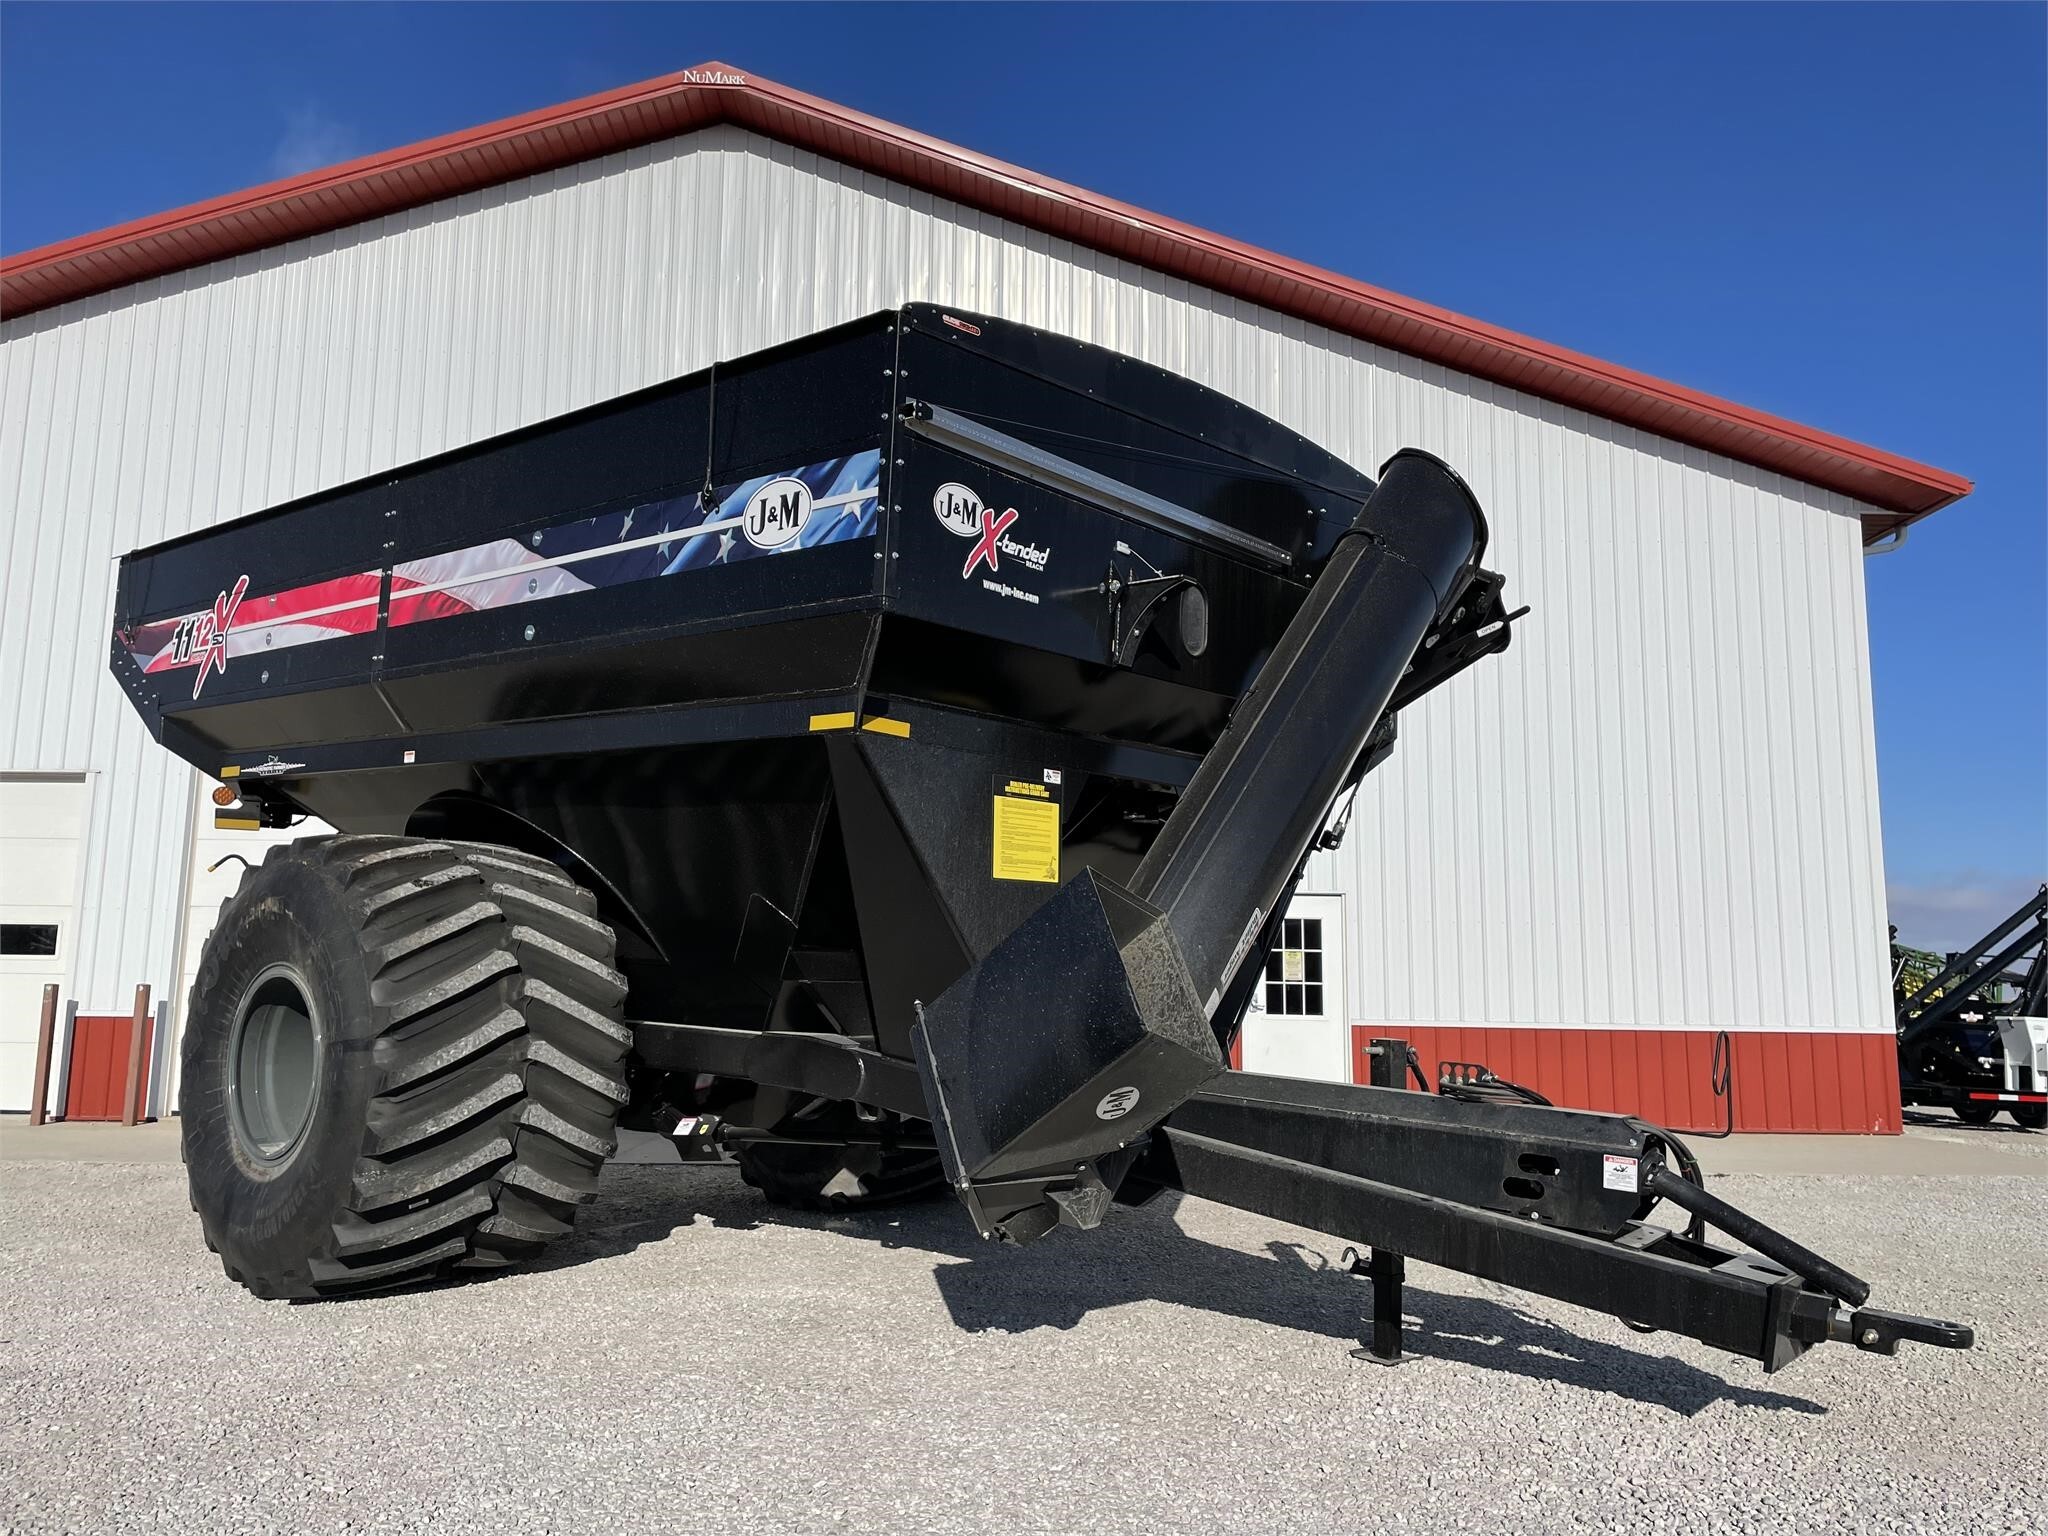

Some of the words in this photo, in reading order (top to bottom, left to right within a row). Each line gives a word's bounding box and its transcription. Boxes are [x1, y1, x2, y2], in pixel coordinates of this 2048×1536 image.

[750, 490, 802, 536] J&M
[940, 492, 978, 528] J&M
[1025, 560, 1044, 572] REACH
[982, 578, 1040, 605] www.jm-inc.com
[1481, 624, 1497, 634] OPEN
[1102, 1089, 1135, 1118] J&M
